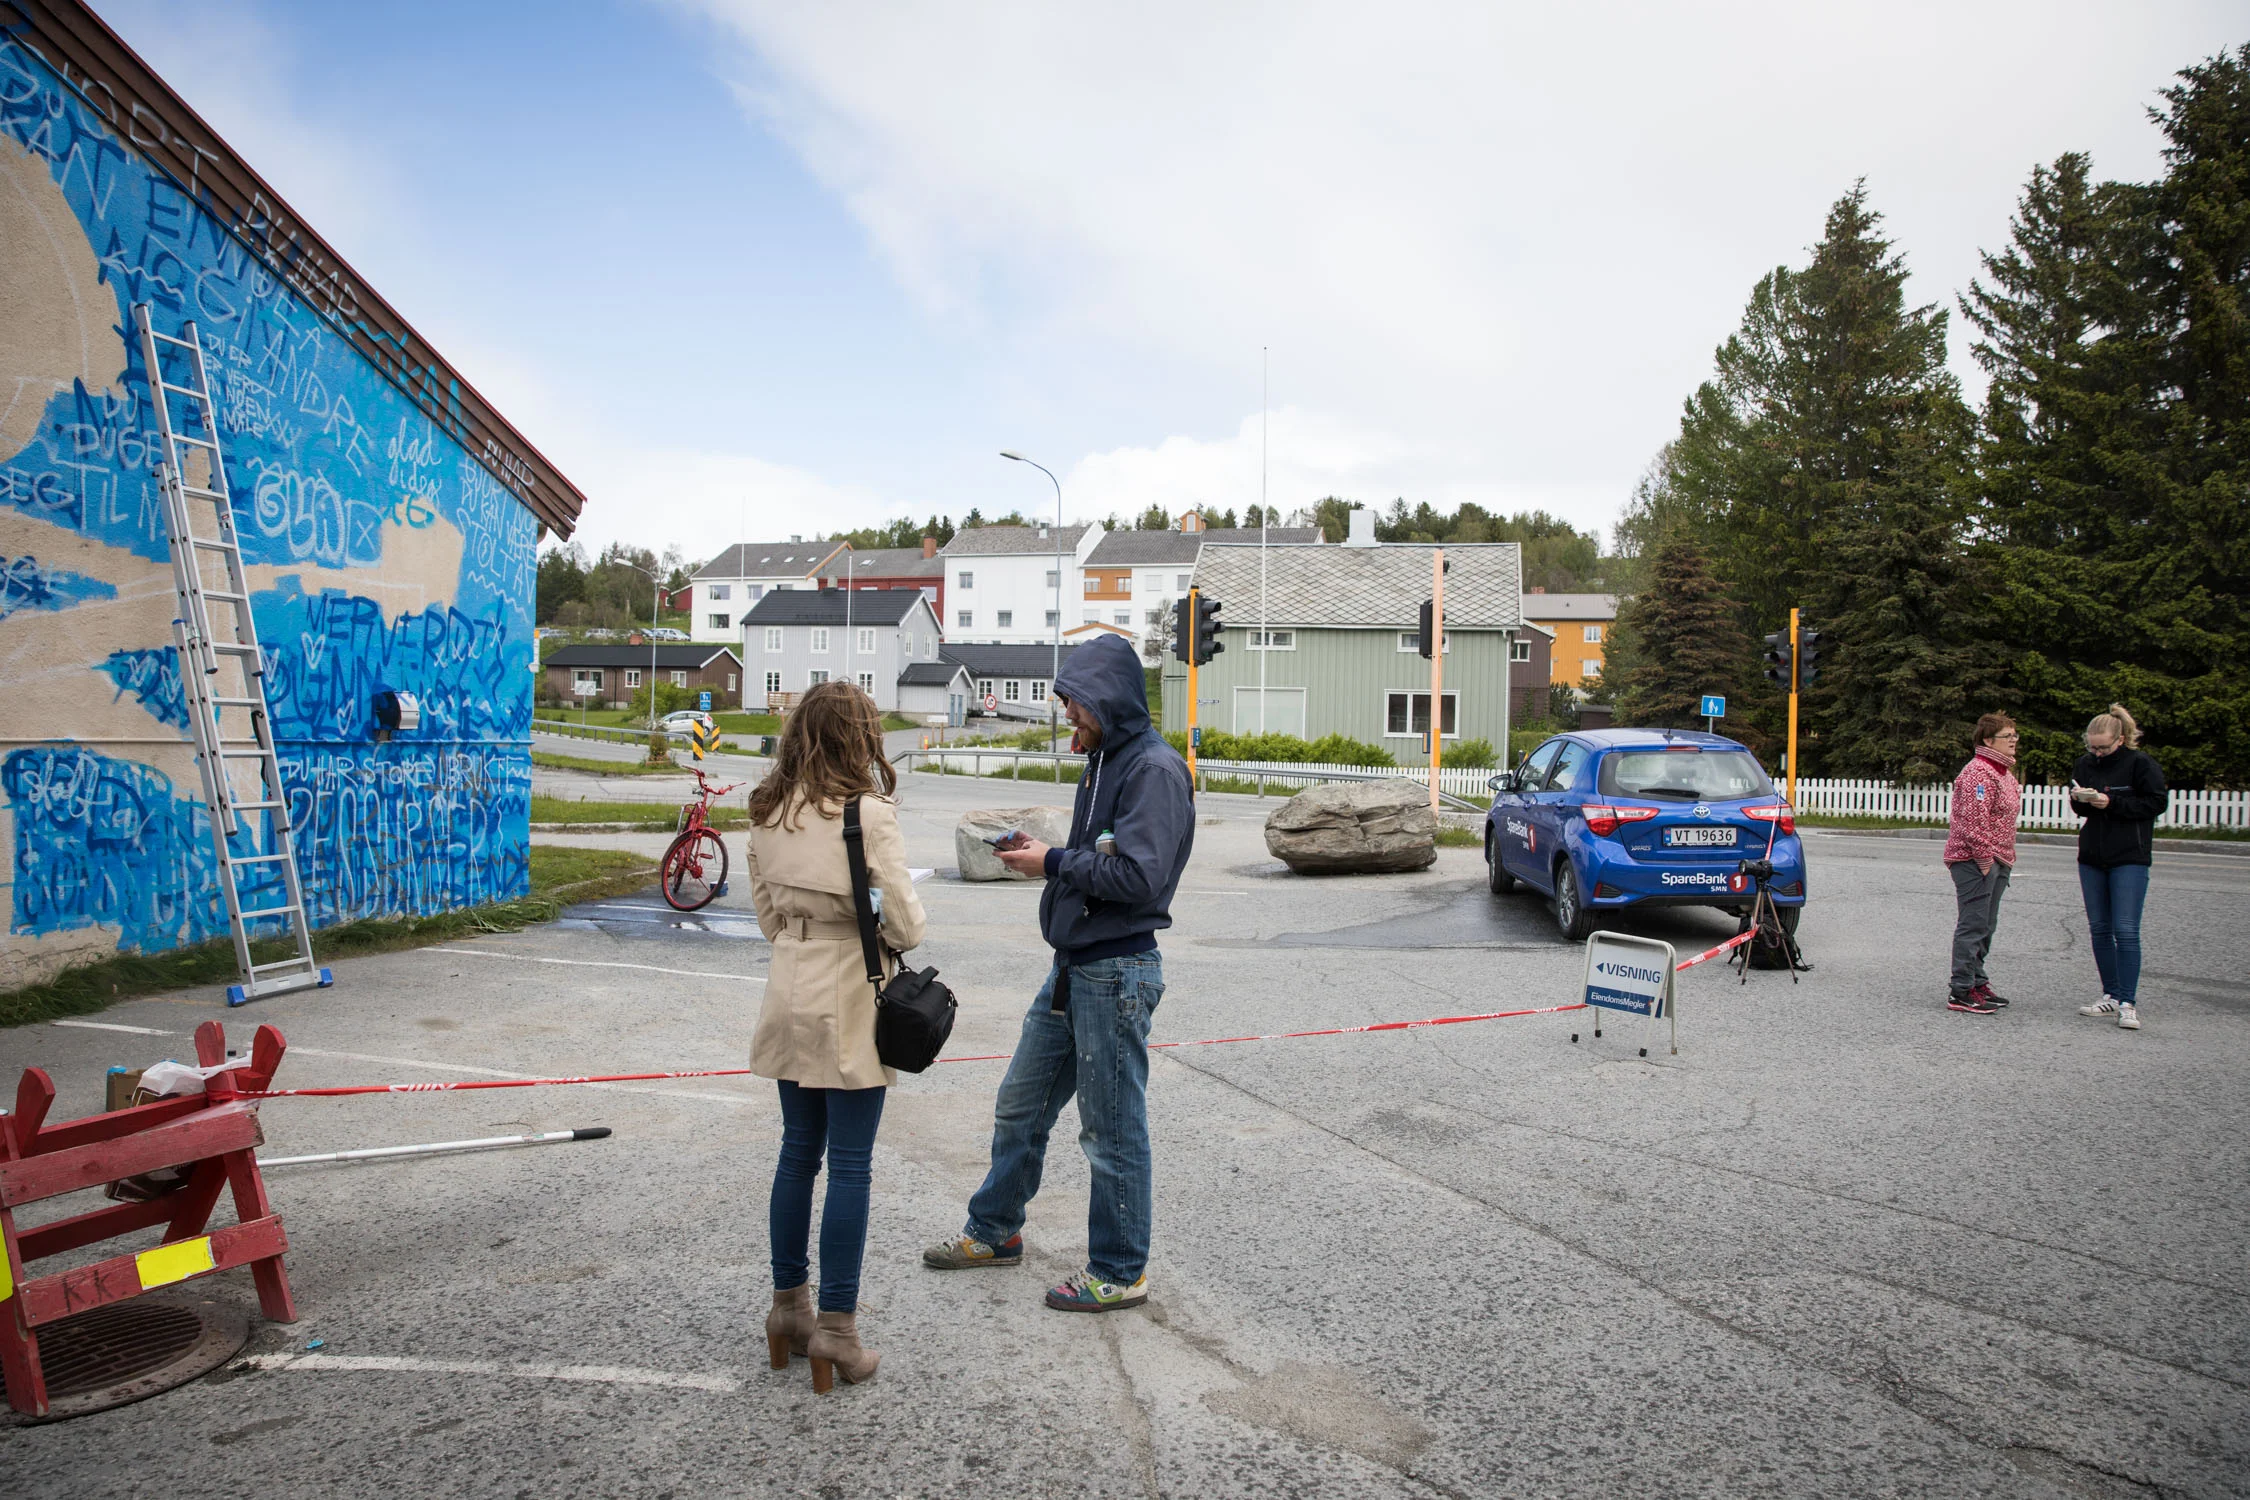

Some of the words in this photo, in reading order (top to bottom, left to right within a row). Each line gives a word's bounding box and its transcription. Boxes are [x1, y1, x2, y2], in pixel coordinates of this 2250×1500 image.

[387, 416, 442, 487] glad
[1674, 829, 1691, 842] VT
[1696, 829, 1733, 842] 19636
[1661, 872, 1727, 887] SpareBank
[1606, 962, 1662, 984] VISNING
[1590, 991, 1647, 1009] EiendomsMegler
